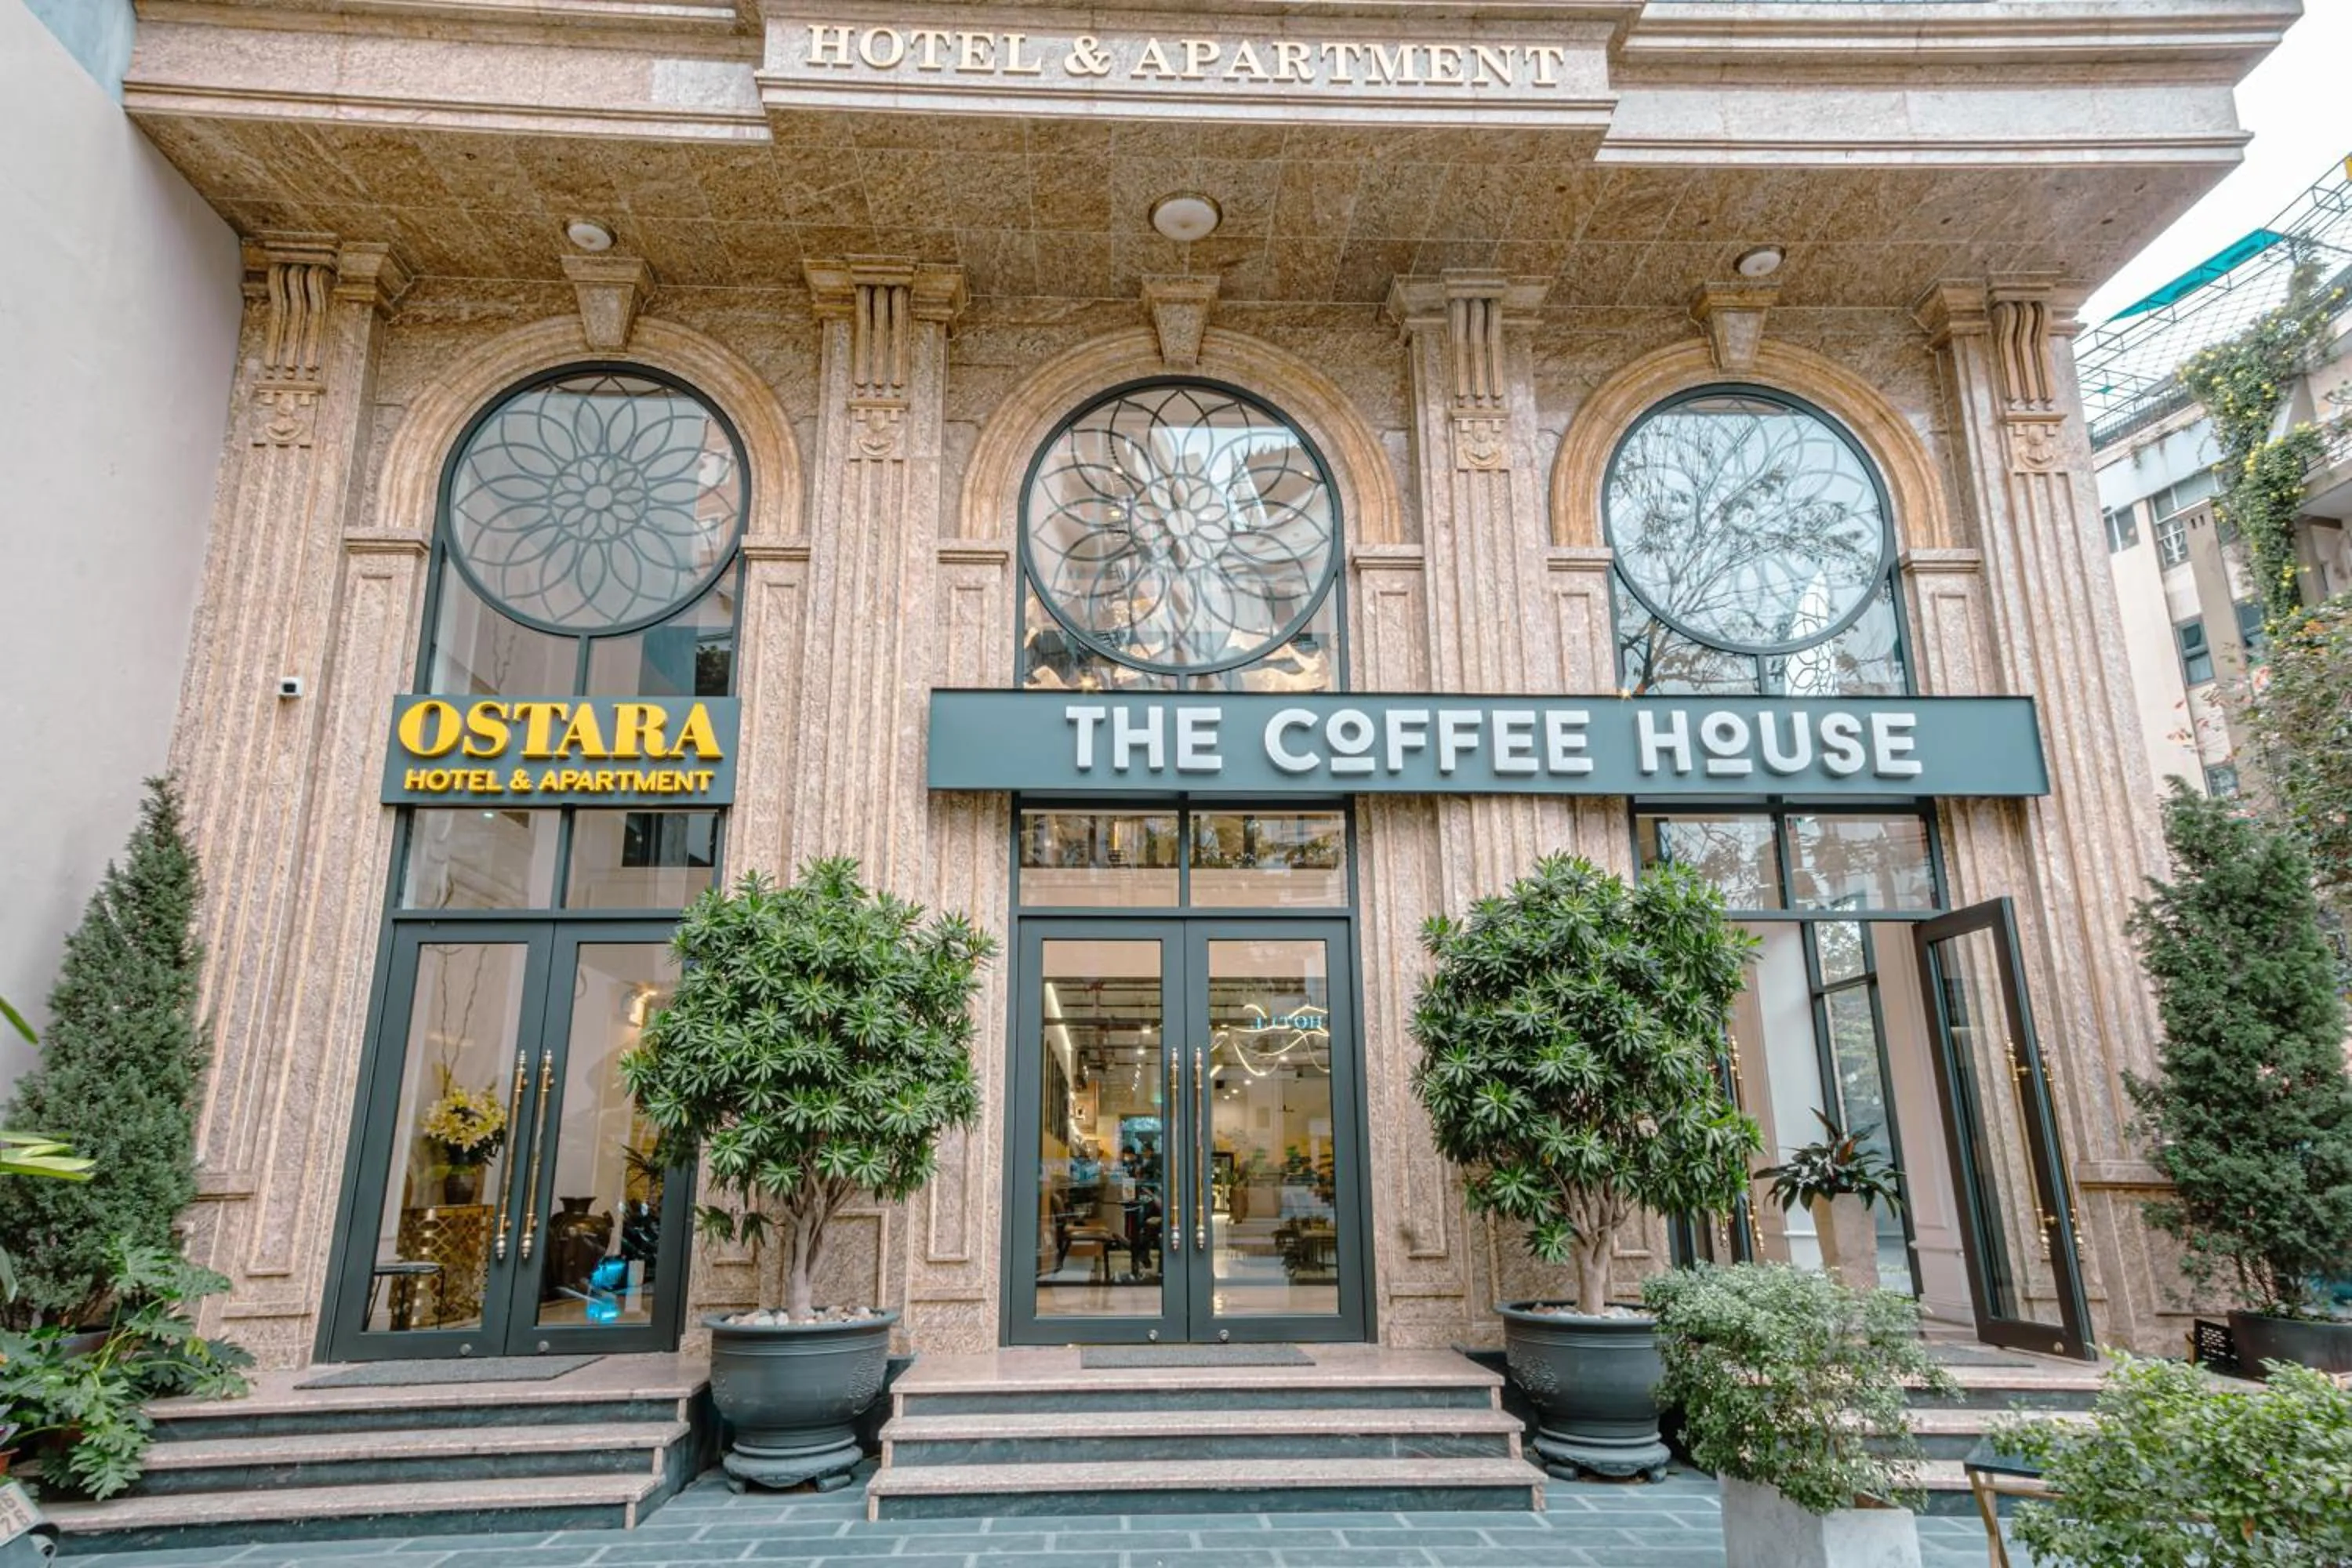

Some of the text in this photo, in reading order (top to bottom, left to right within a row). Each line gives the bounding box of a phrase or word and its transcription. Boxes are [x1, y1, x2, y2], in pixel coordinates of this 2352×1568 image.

[806, 24, 1565, 87] HOTEL & APARTMENT
[397, 699, 724, 760] OSTARA
[1065, 705, 1923, 778] THE COFFEE HOUSE
[404, 767, 714, 796] HOTEL & APARTMENT
